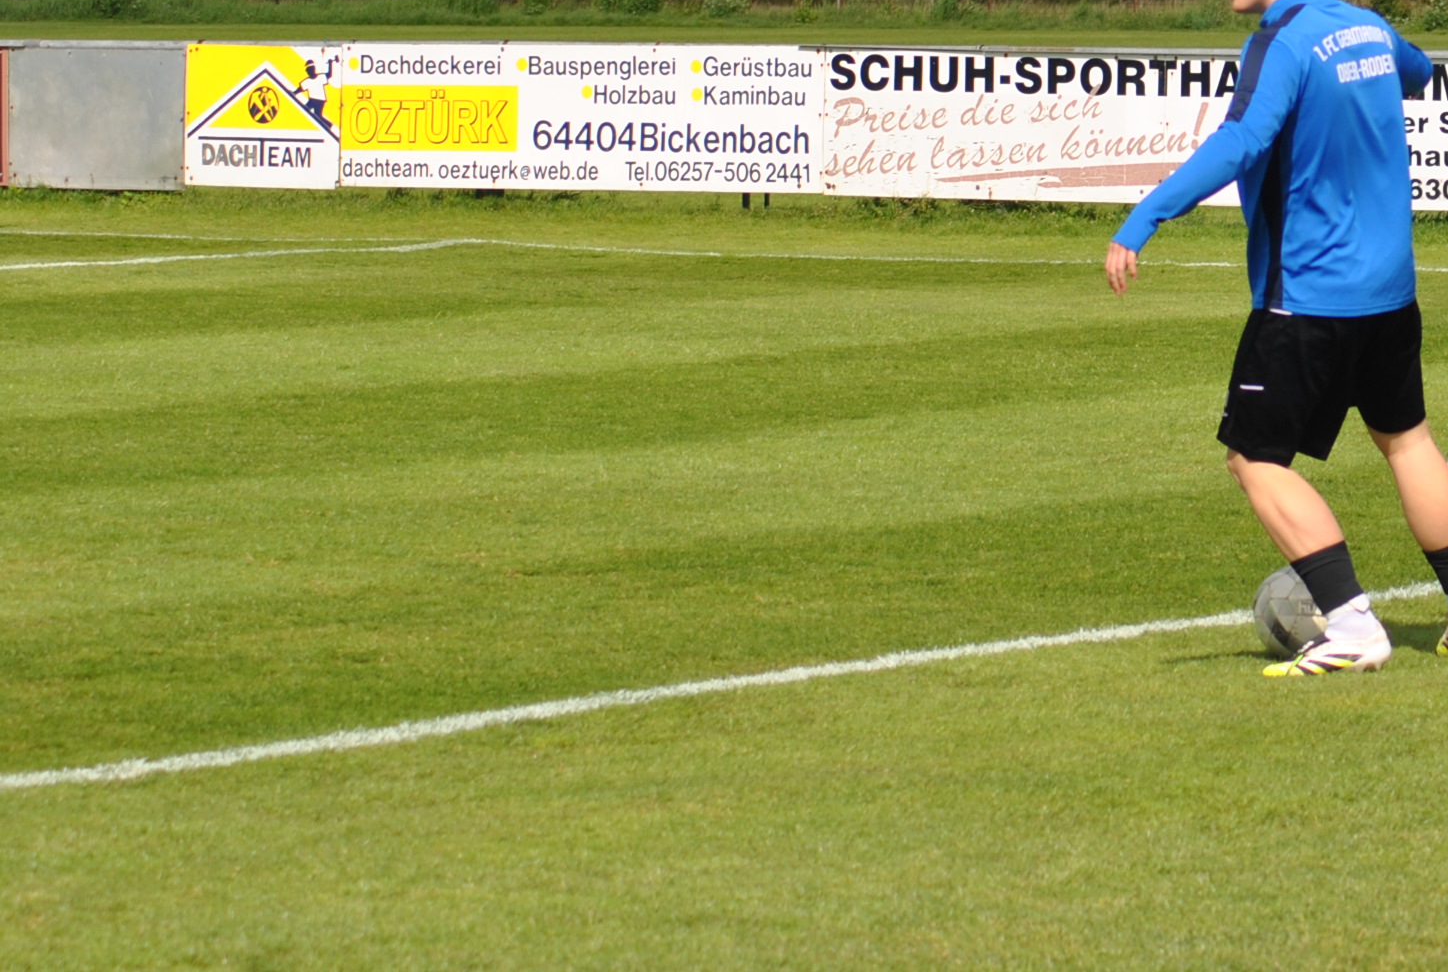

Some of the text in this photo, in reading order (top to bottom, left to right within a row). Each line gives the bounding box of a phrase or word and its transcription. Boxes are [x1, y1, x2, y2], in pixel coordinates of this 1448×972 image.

[359, 54, 813, 80] Dachdeckerei Bauspenglerei Gerüstbau
[1335, 53, 1396, 84] OBER-RODE
[349, 89, 509, 145] ÖZTÜRK
[592, 85, 806, 107] Holzbau Kaminbau
[833, 84, 1103, 139] Preise die sich
[825, 101, 1210, 178] sehen lassen können!
